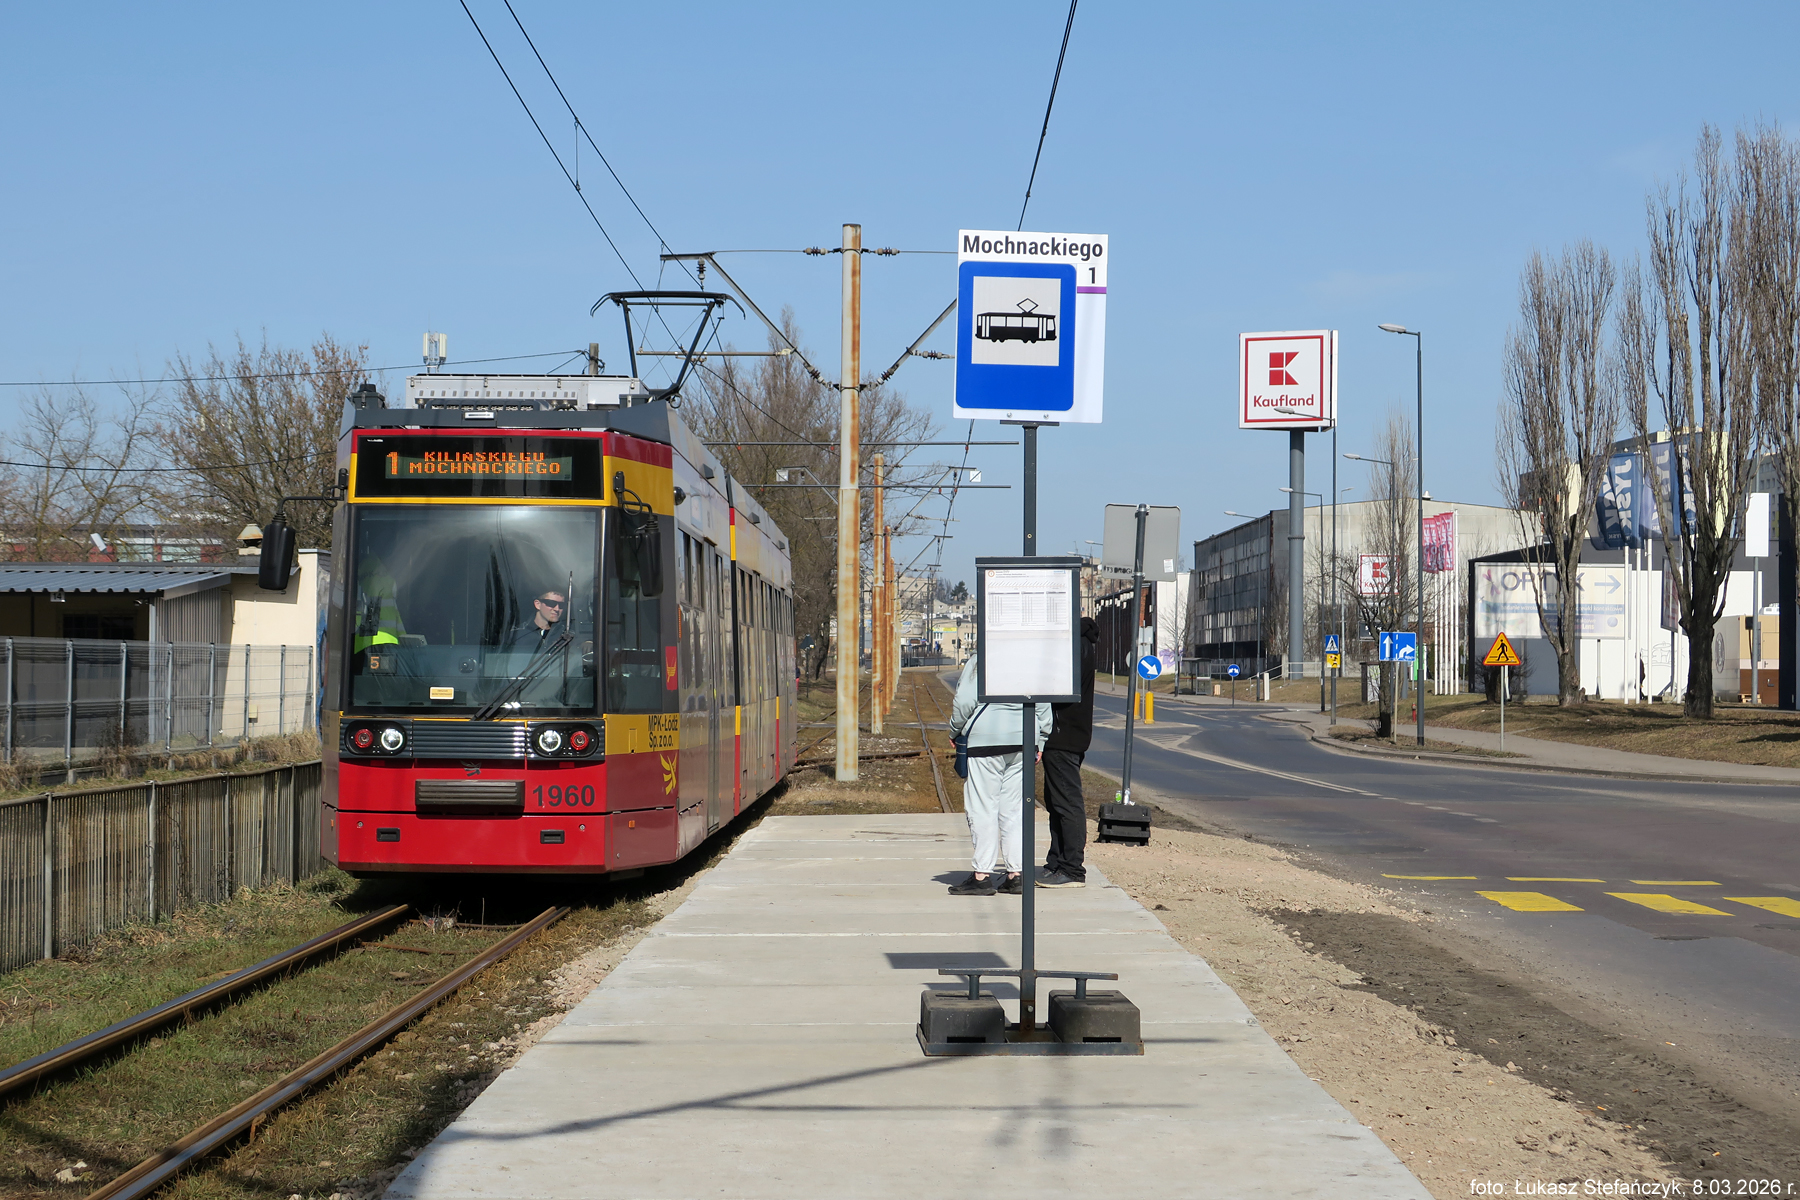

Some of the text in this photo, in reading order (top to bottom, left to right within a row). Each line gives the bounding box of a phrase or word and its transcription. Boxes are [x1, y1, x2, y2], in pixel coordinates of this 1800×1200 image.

[963, 235, 1104, 262] Mochnackiego
[1088, 266, 1096, 285] 1
[1253, 393, 1314, 408] Kaufland
[386, 451, 398, 475] 1
[409, 462, 561, 474] MOCHNACKIEGO
[370, 656, 380, 669] 5
[532, 784, 595, 807] 1960
